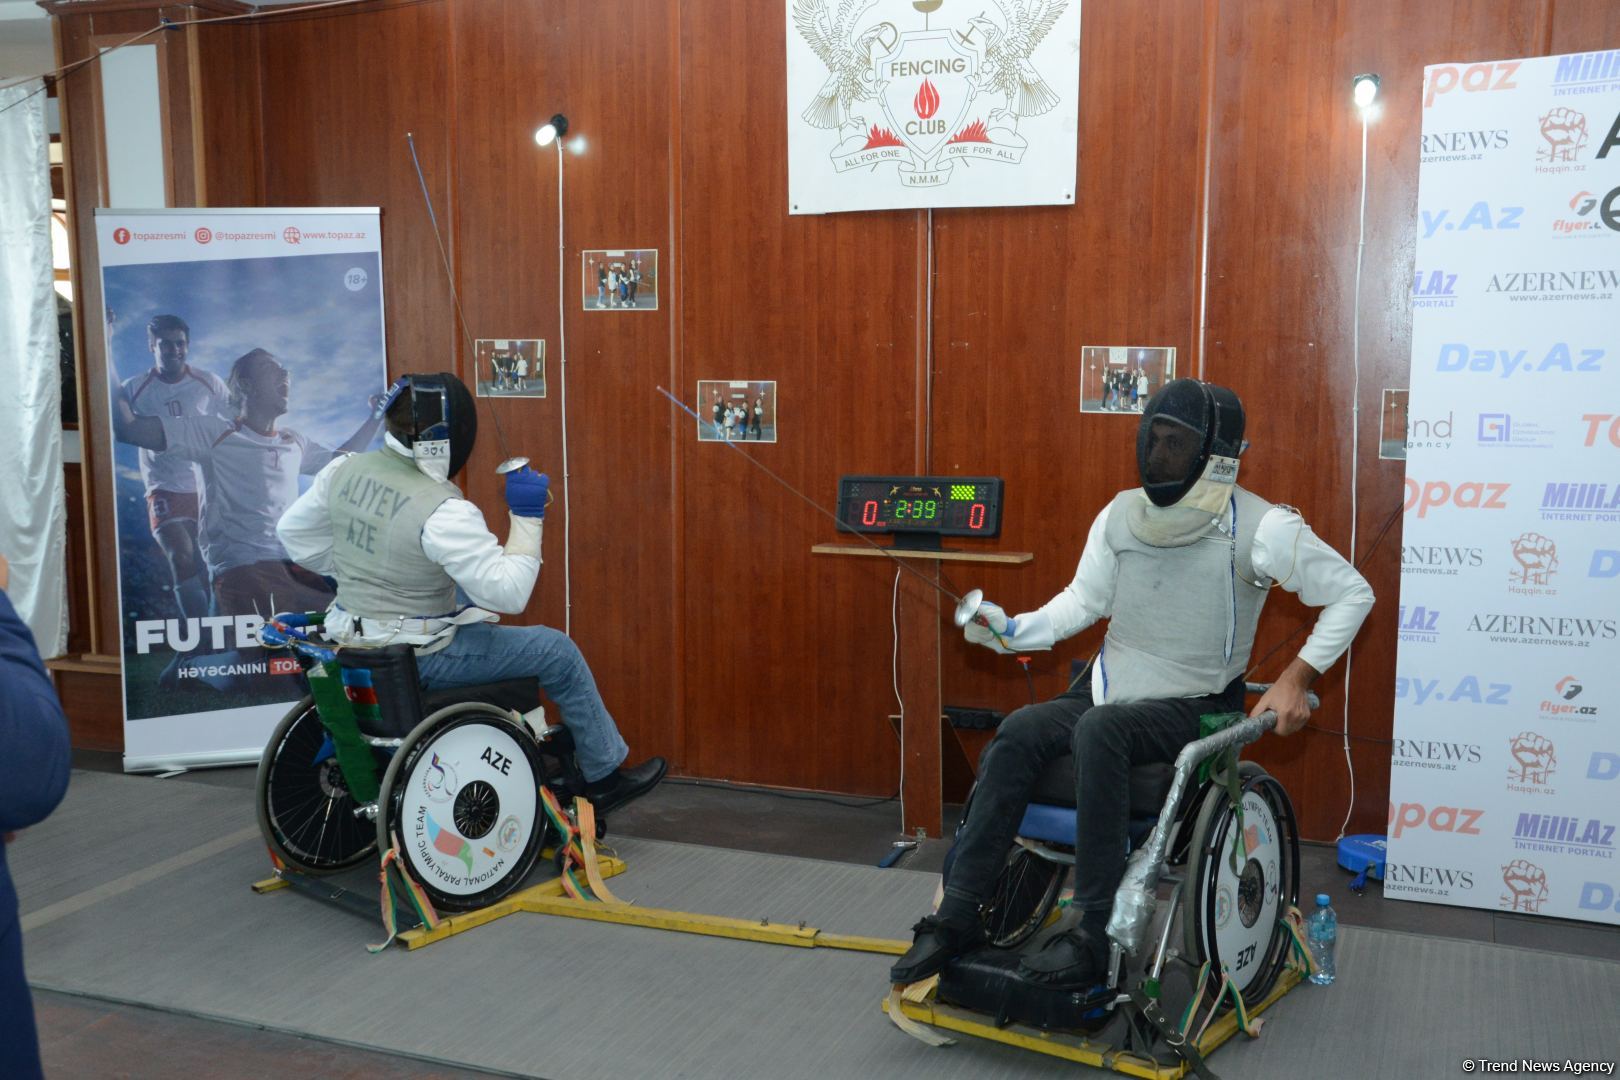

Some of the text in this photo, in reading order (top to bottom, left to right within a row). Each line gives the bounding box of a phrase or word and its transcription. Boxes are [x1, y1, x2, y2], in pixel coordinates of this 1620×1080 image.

[890, 58, 967, 77] FENCING
[1423, 62, 1522, 108] paz
[905, 119, 947, 136] CLUB
[844, 149, 901, 169] ALL FOR ONE
[948, 145, 1016, 161] ONE FOR ALL
[1420, 153, 1483, 164] zernews.az
[909, 174, 942, 186] N.M.M.
[302, 230, 366, 241] www.topaz.az
[1552, 219, 1602, 233] flyer.
[133, 230, 187, 242] topazresmi
[214, 230, 277, 242] @topazresmi
[347, 274, 368, 285] 18+
[1509, 292, 1613, 302] www.azernews.az
[1436, 342, 1606, 379] Day.Az
[1408, 411, 1453, 439] nd
[338, 473, 412, 521] ALIYEV
[862, 500, 879, 526] 0
[969, 503, 986, 529] 0
[345, 516, 378, 555] AZE
[1466, 614, 1618, 640] AZERNEWS
[1490, 635, 1590, 648] www.azernews.az
[178, 662, 267, 679] HƏYƏCANINI
[1539, 700, 1598, 716] flyer.az
[480, 746, 513, 777] AZE
[1387, 799, 1485, 839] paz
[1514, 812, 1616, 846] Milli.Az
[415, 805, 505, 887] NATIONAL PARALYMPIC TEAM
[1235, 941, 1258, 972] AZE
